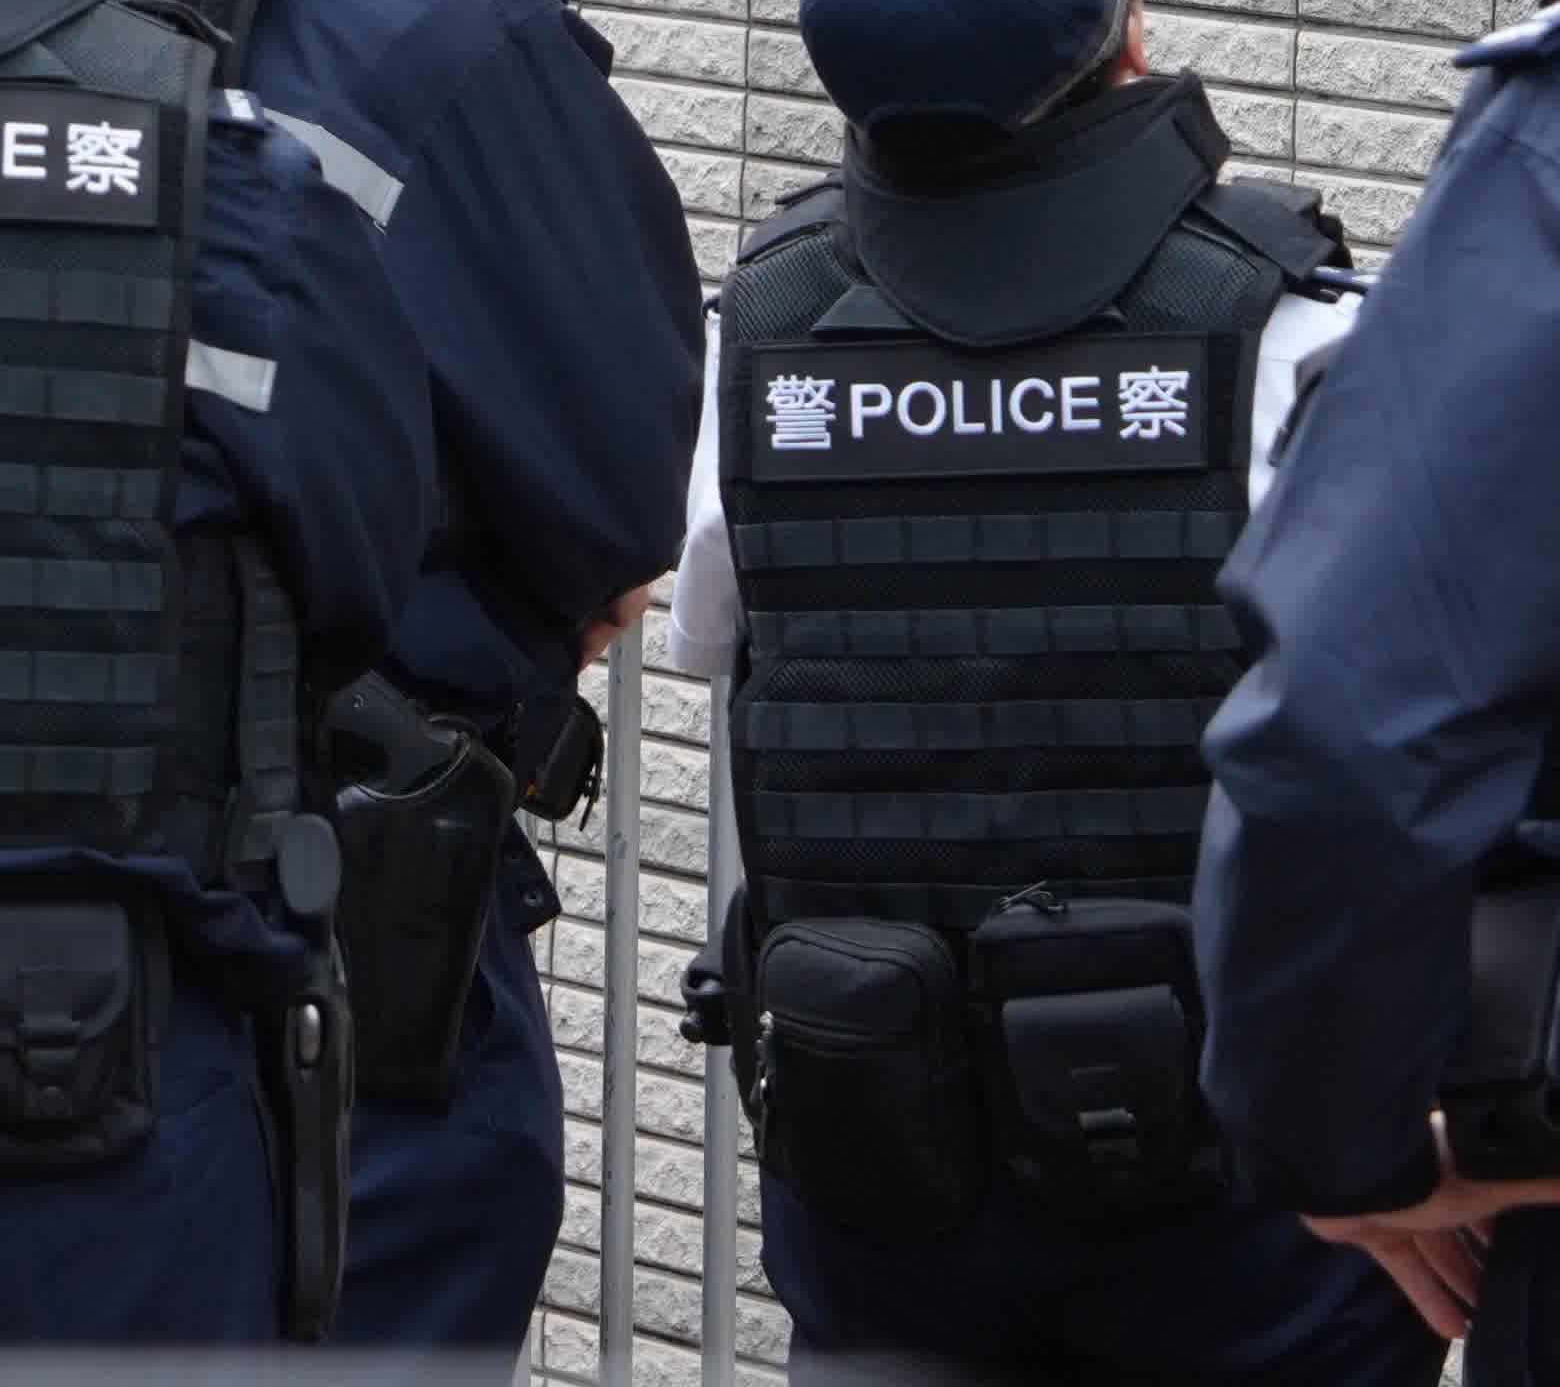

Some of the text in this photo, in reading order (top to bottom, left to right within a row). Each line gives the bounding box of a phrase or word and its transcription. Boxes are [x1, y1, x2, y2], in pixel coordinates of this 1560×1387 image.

[65, 121, 143, 195] 察
[765, 365, 1190, 449] 警 POLICE 察
